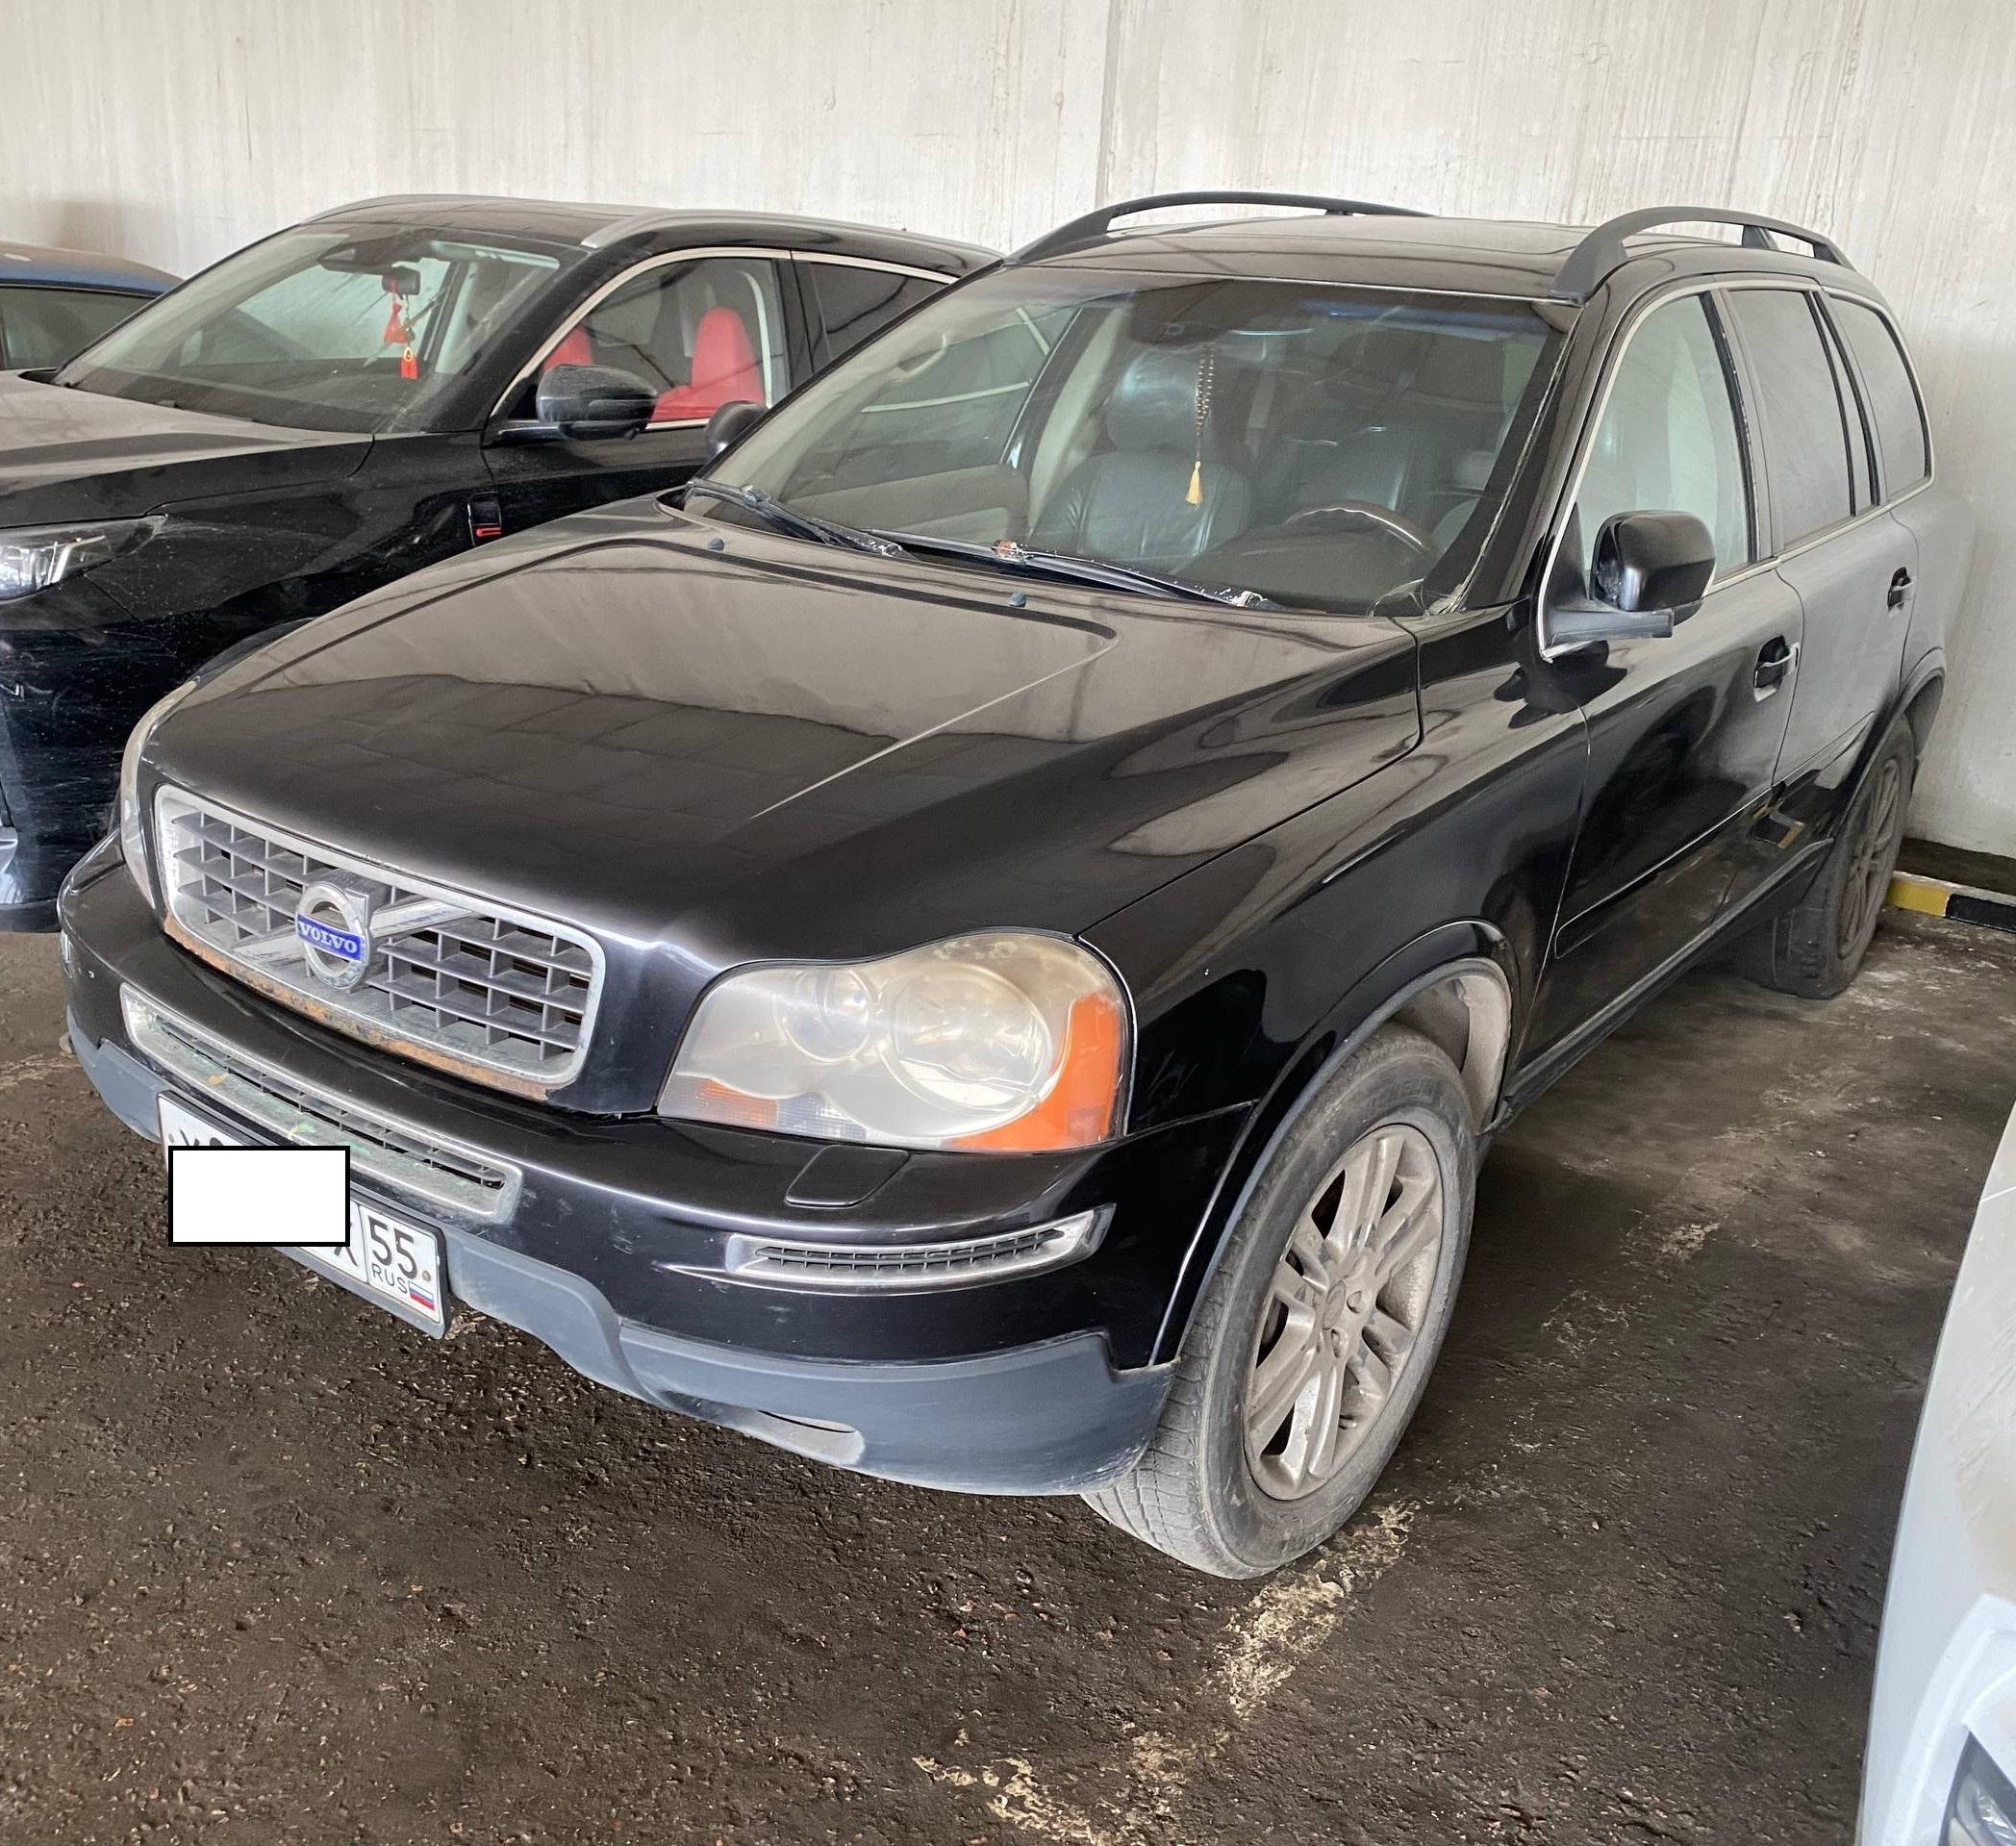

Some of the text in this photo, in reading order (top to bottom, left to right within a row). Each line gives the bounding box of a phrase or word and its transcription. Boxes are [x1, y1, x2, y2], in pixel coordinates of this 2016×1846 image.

[297, 921, 358, 954] VOLVO
[367, 1216, 417, 1280] 55
[371, 1263, 408, 1294] RUS
